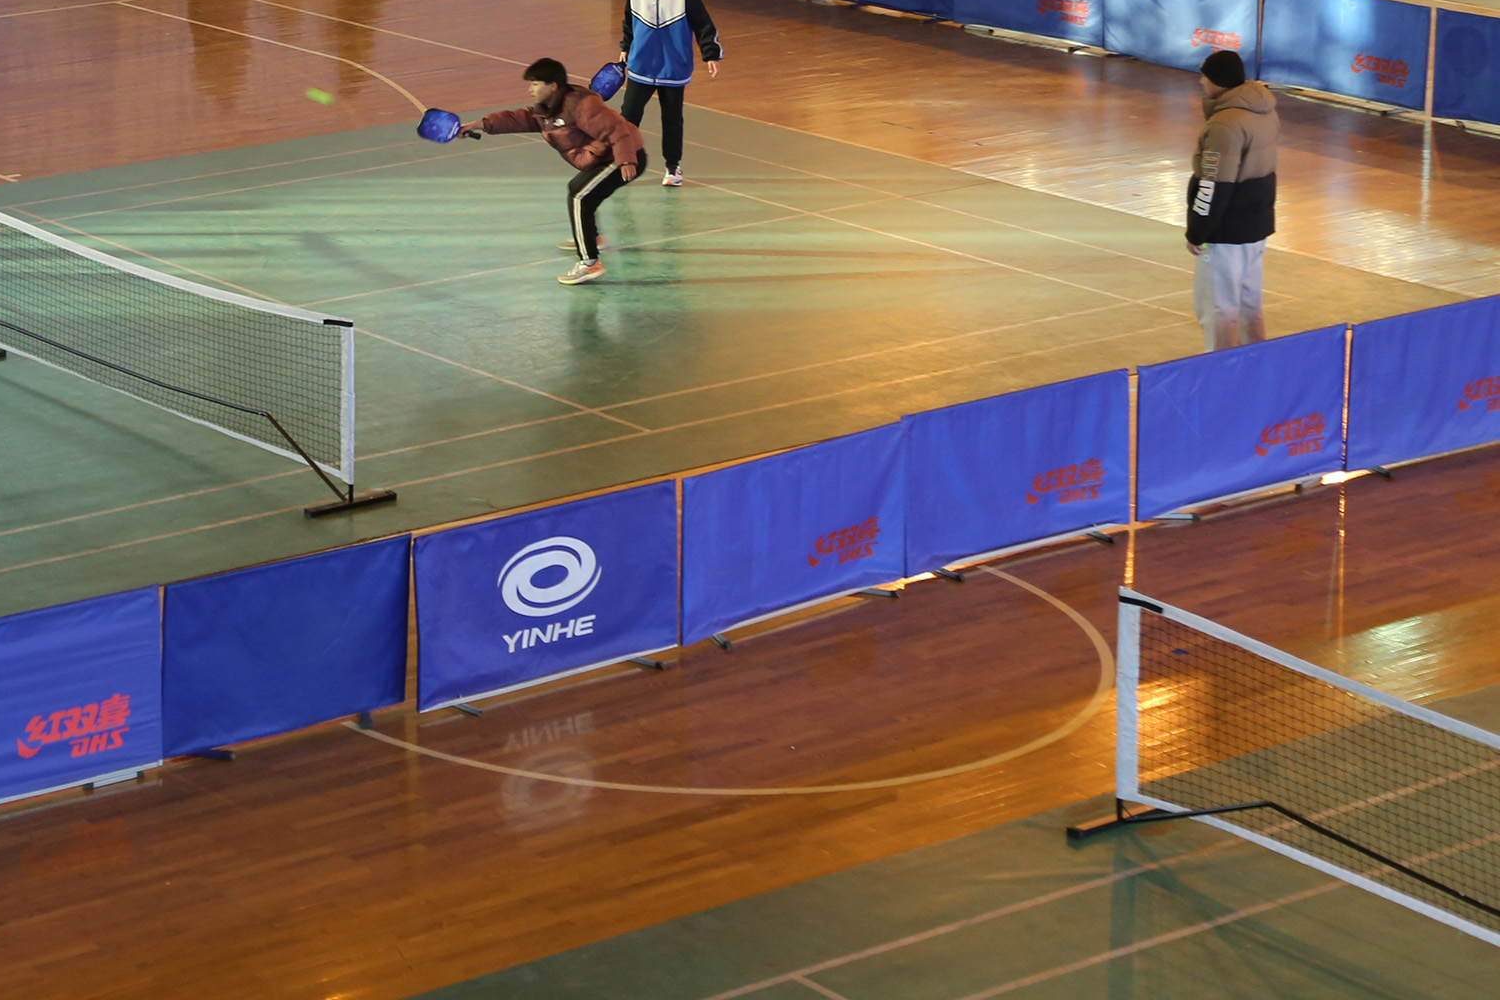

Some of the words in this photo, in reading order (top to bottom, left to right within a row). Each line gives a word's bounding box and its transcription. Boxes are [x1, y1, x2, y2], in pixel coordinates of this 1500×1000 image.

[502, 614, 596, 653] YINHE
[17, 693, 131, 758] 红双喜
[69, 727, 130, 758] DHS
